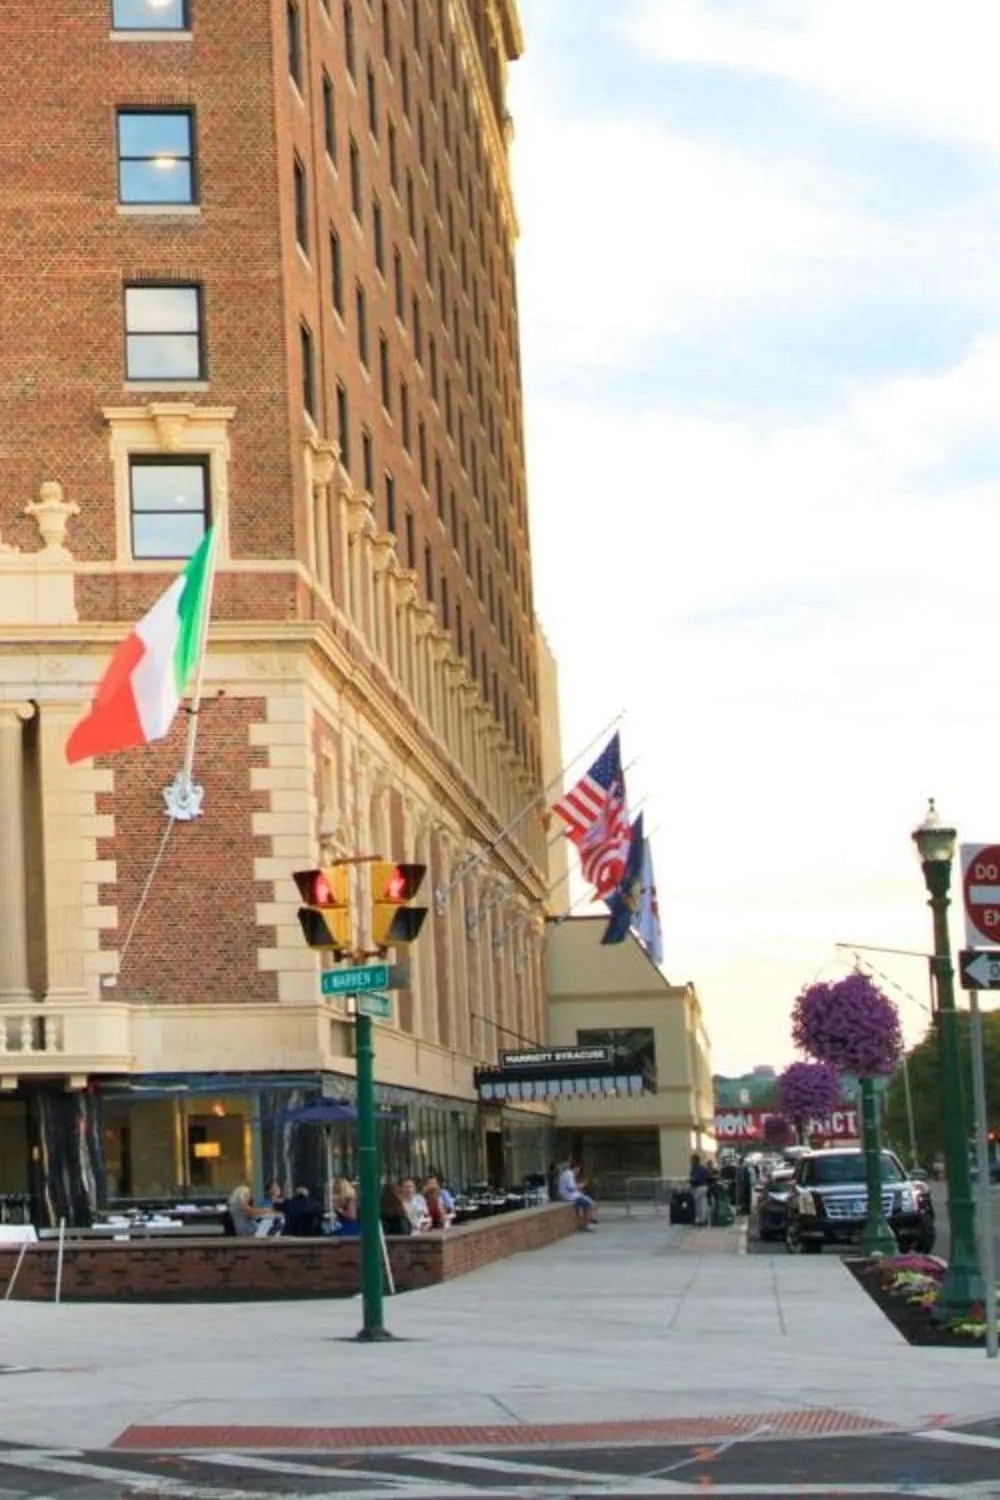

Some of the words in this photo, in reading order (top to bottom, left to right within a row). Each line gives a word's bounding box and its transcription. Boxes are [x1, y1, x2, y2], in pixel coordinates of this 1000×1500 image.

[975, 863, 999, 880] DO
[505, 1053, 552, 1063] MARRIOTT
[555, 1049, 604, 1061] SYRACUSE
